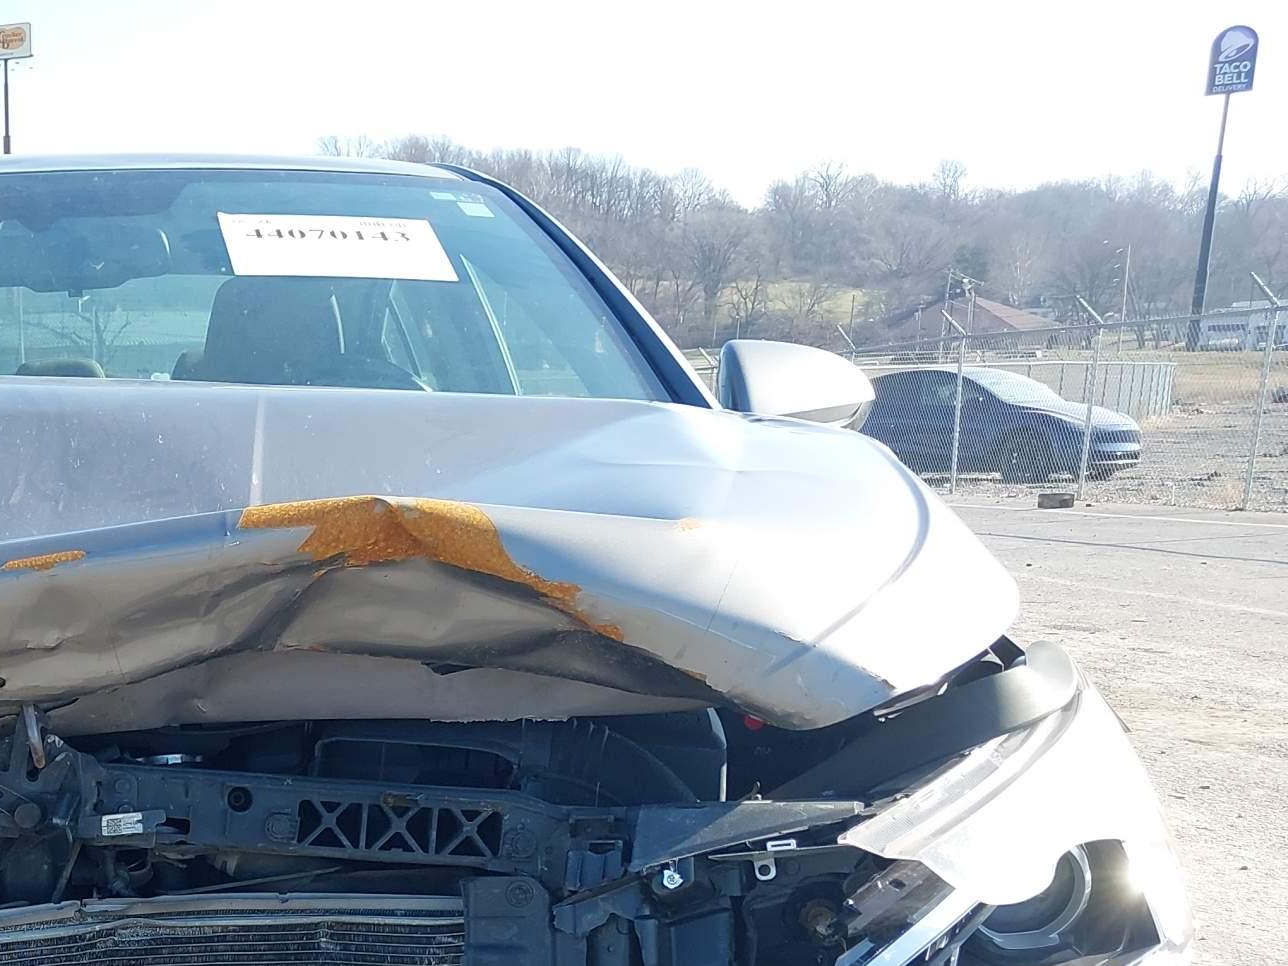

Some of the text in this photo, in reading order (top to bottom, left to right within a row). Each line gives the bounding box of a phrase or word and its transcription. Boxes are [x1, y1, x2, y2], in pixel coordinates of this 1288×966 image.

[1214, 61, 1252, 75] TACO
[1214, 72, 1249, 86] BELL
[245, 228, 411, 242] 44070143
